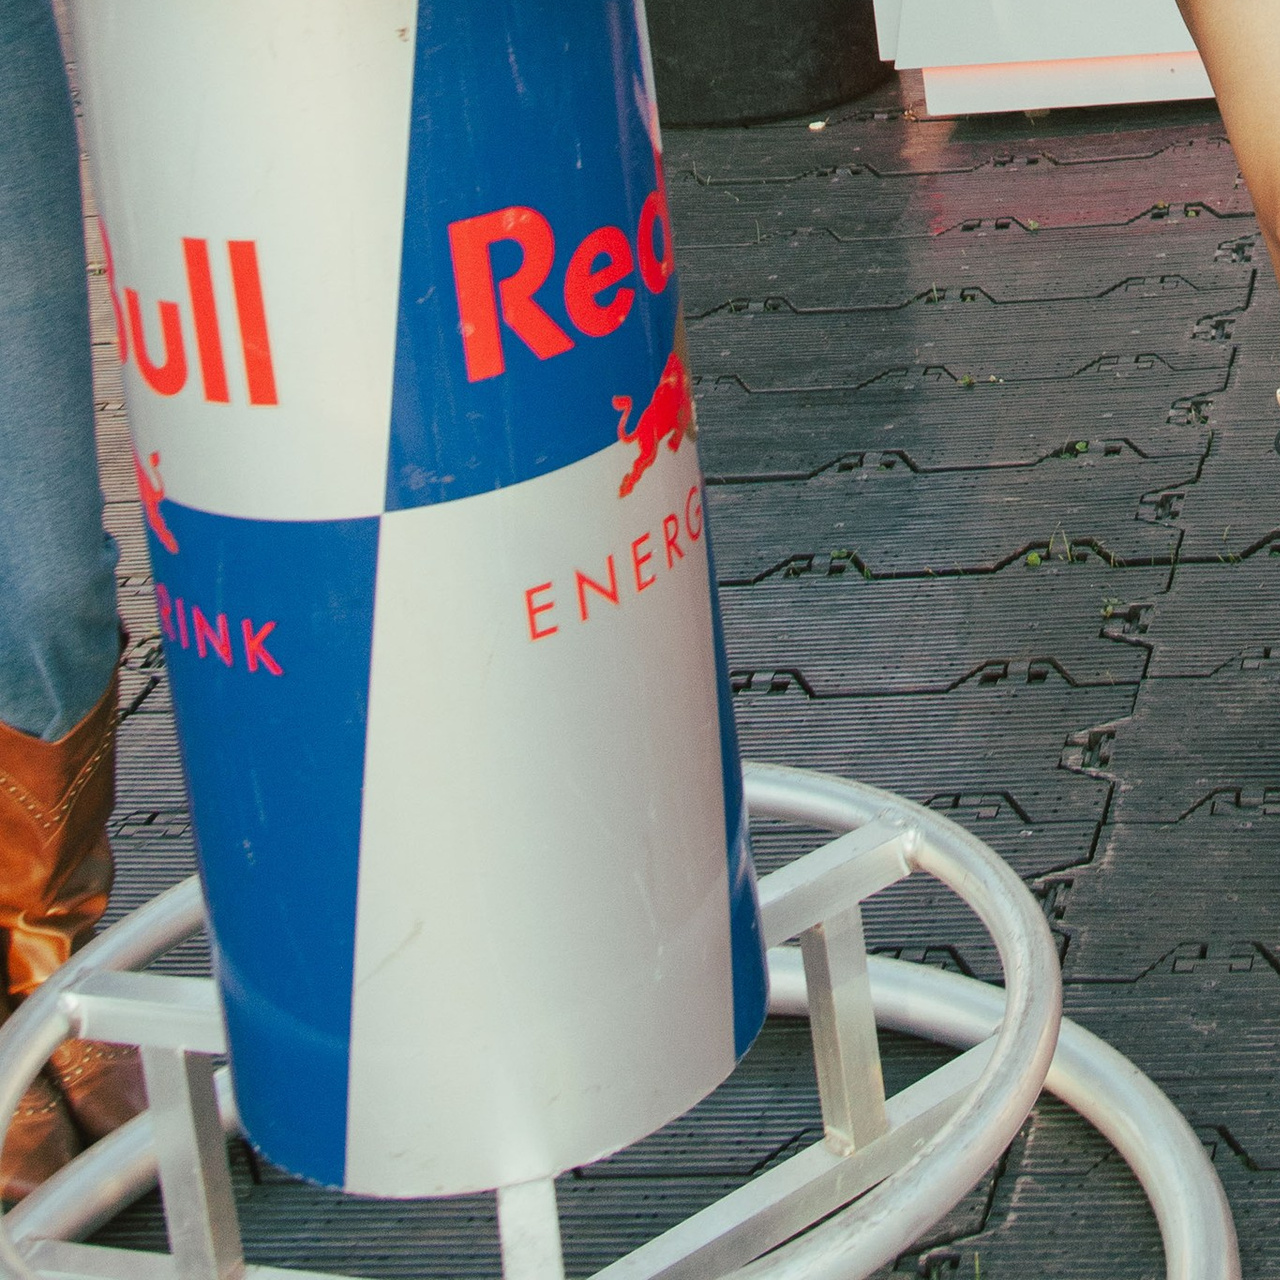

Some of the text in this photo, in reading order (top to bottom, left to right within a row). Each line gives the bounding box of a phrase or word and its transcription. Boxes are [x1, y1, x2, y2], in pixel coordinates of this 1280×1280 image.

[112, 225, 280, 407] ull
[448, 108, 676, 384] Red
[155, 583, 284, 676] RINK
[523, 485, 704, 641] ENERG
